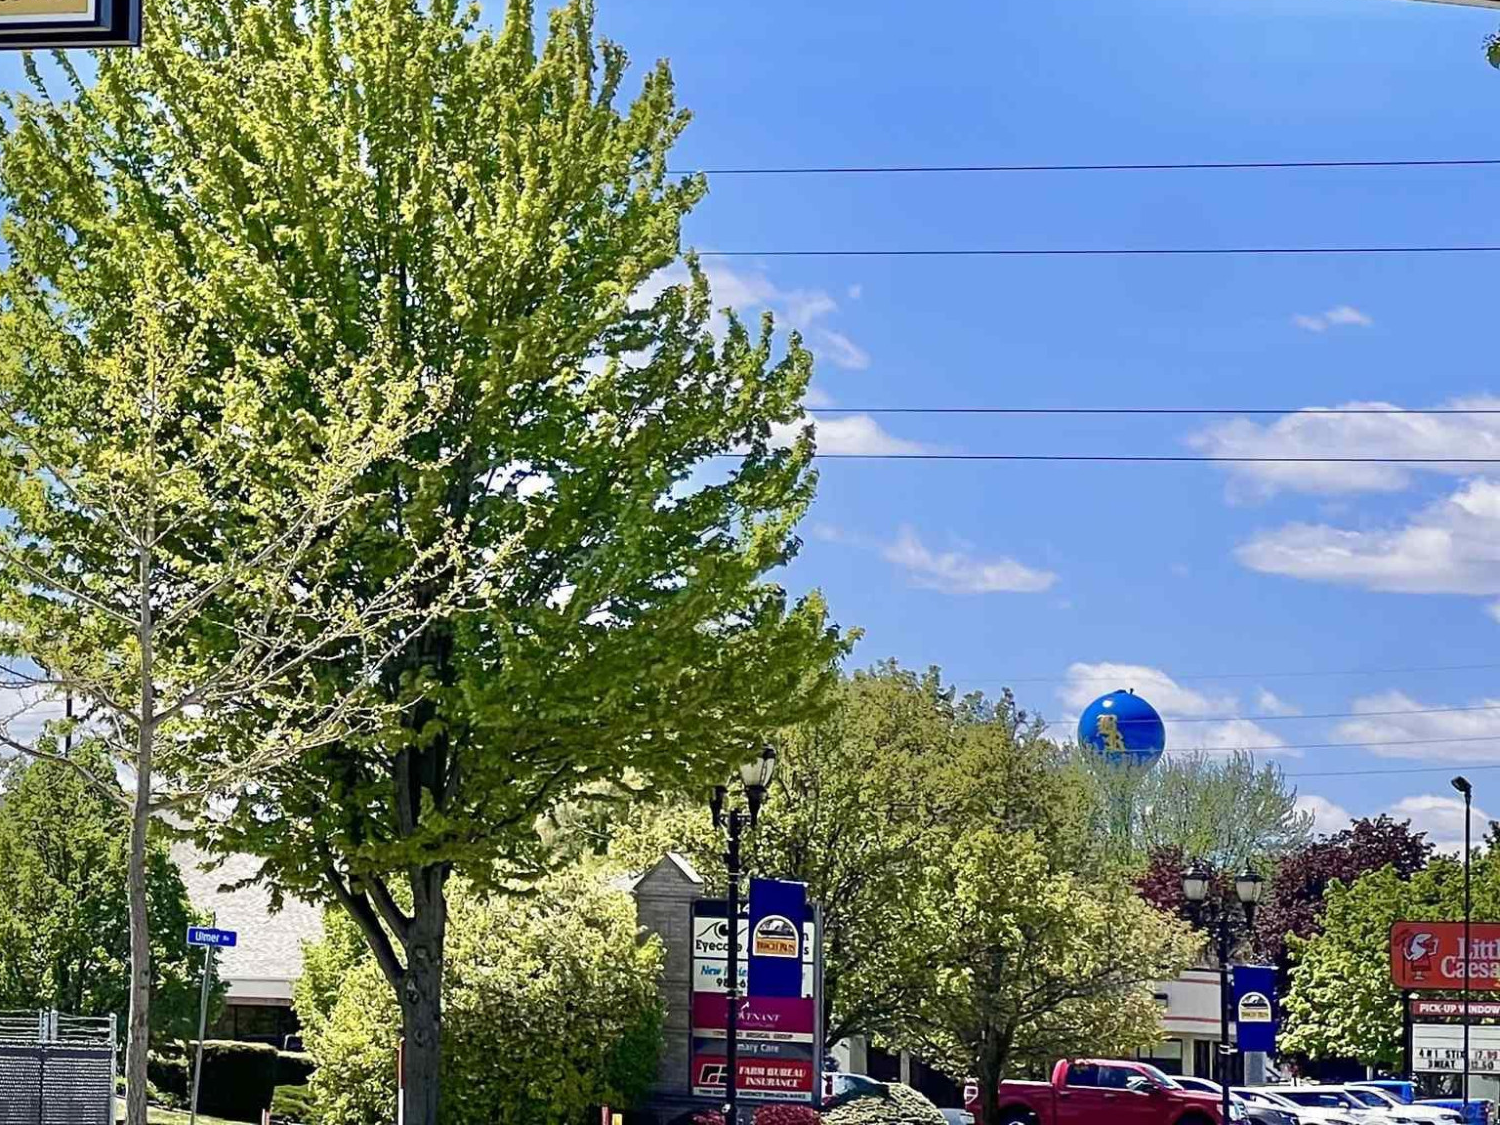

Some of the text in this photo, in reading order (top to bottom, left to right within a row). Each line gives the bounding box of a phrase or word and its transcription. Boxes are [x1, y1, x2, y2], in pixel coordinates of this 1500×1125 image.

[695, 939, 743, 953] Eyecae
[1457, 937, 1500, 960] Littl
[1440, 955, 1500, 978] Caesa
[739, 1065, 806, 1078] FARM BUREAU
[745, 1076, 802, 1088] INSURANCE
